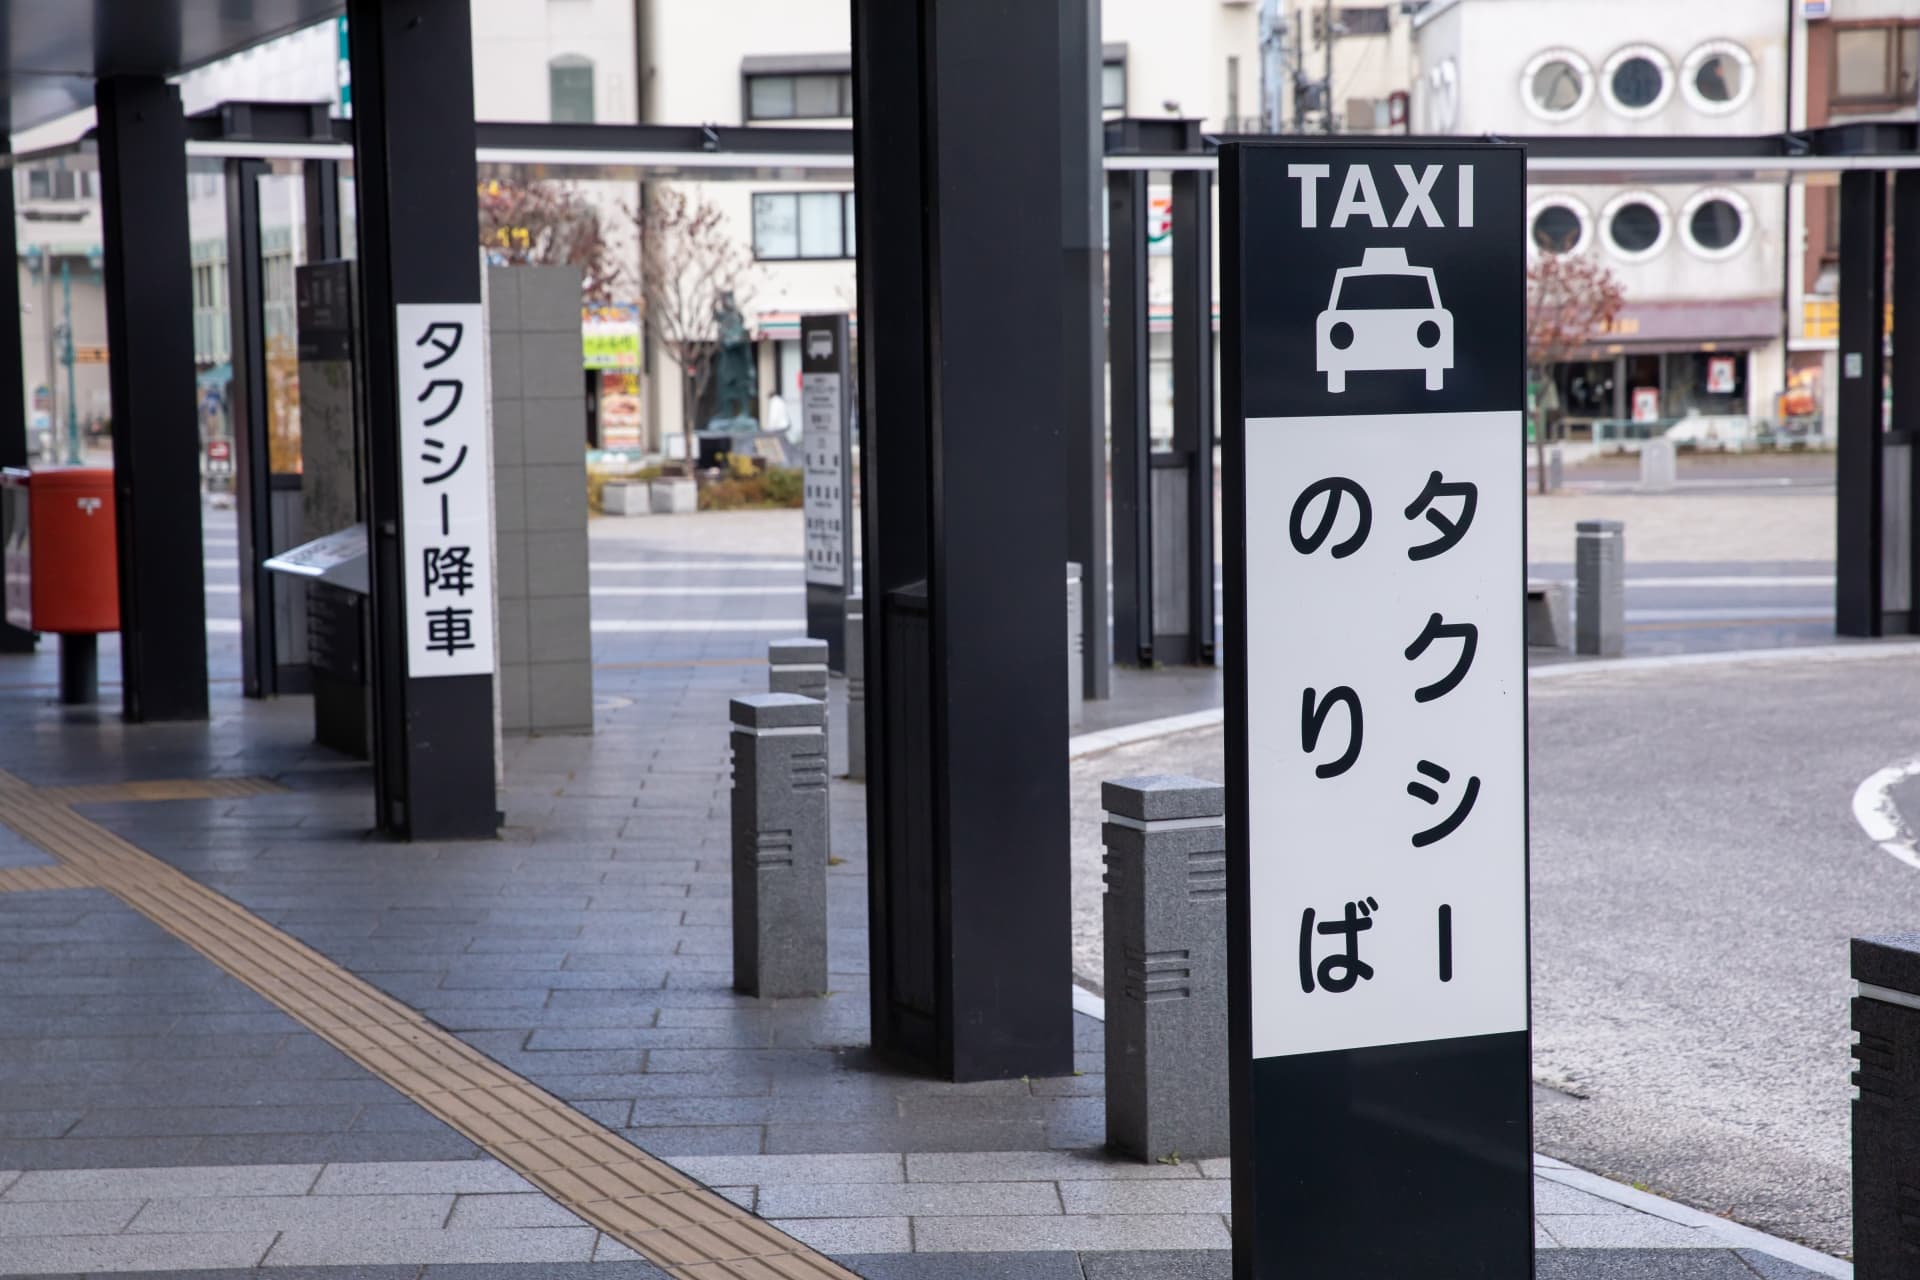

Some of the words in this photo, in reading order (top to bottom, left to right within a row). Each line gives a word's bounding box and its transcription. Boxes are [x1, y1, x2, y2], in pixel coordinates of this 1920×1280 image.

[1287, 163, 1474, 229] TAXI
[415, 321, 477, 658] タクシー降車
[1288, 475, 1379, 995] のりば
[1403, 469, 1481, 984] タクシー
